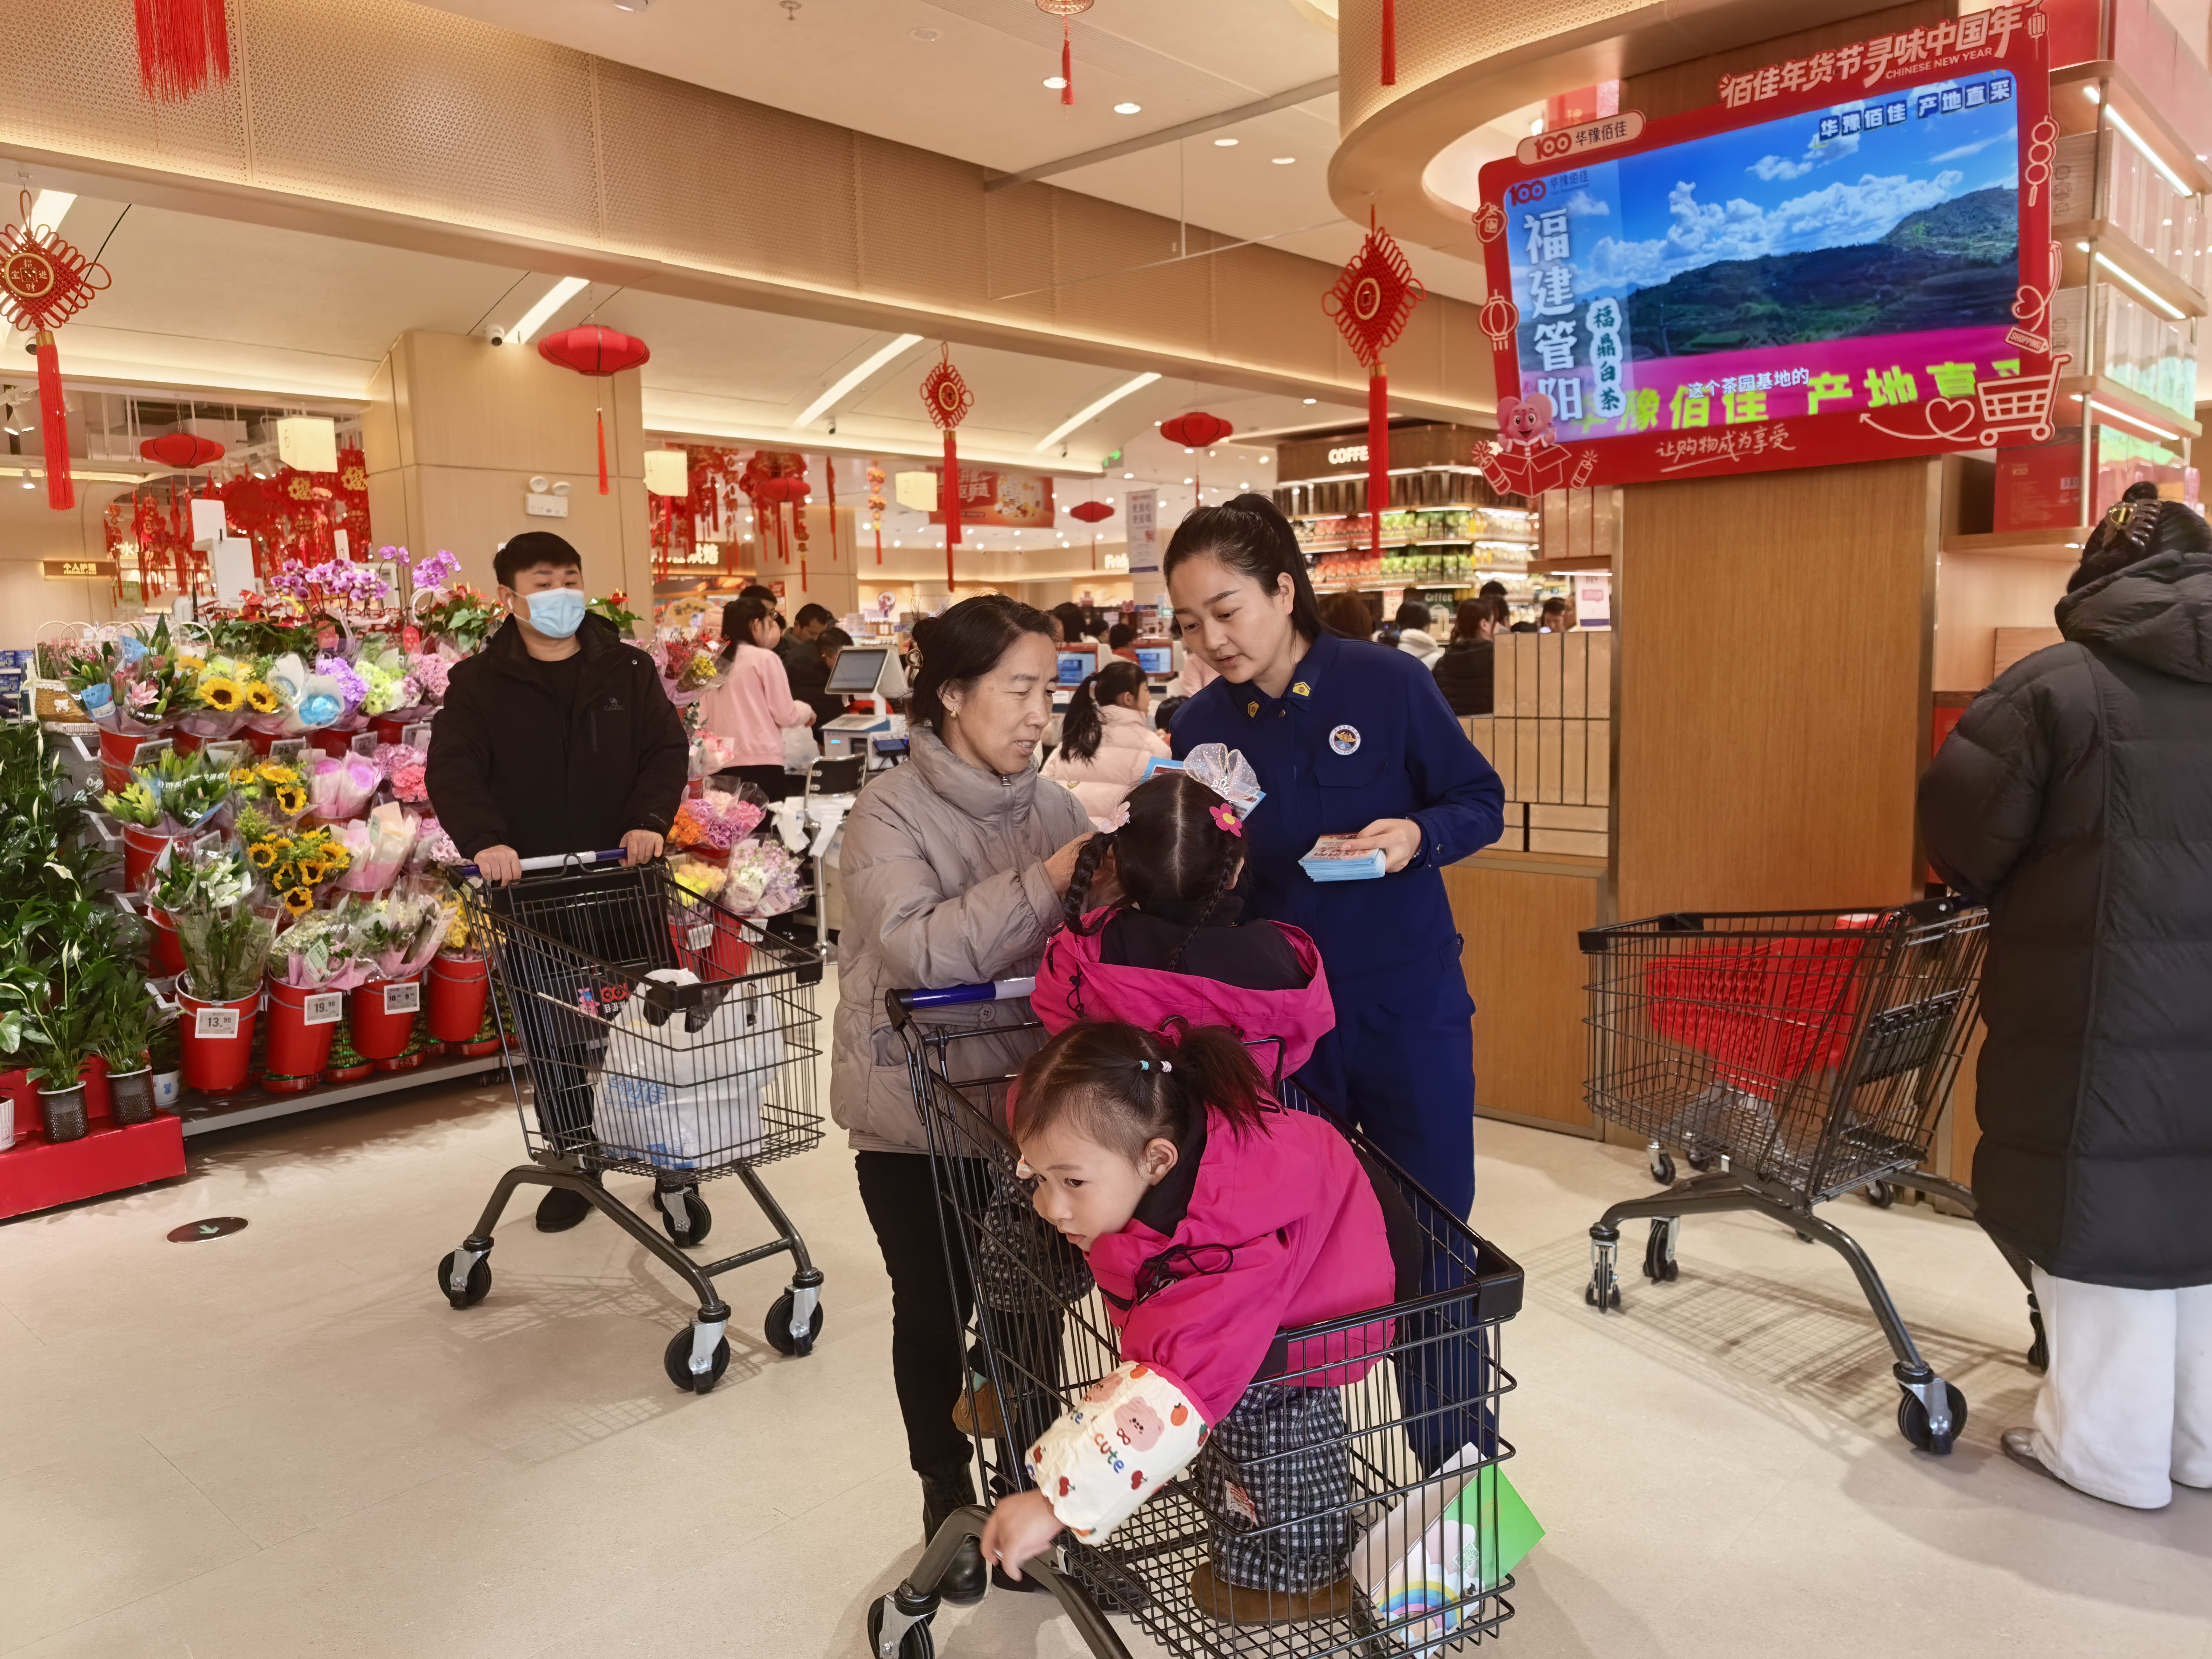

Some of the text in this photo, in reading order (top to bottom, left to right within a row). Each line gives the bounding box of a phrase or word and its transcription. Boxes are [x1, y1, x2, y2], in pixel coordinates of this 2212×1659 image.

[1722, 6, 2023, 108] 佰佳年货节寻味中国年
[1885, 47, 1992, 80] CHINESE NEW YEAR
[1820, 80, 2012, 138] 华豫佰佳 产地直采
[1534, 121, 1627, 161] 100 华豫佰佳
[1550, 169, 1589, 188] 华豫佰佳
[1523, 207, 1583, 421] 福建管阳
[2010, 331, 2043, 349] SHOPPING
[1593, 305, 1621, 411] 福鼎白茶
[1688, 367, 1809, 399] 这个茶园基地的
[284, 429, 290, 448] 6
[1328, 445, 1369, 464] COFFE
[1656, 423, 1796, 463] 让购物成为享受
[904, 479, 909, 493] 2
[63, 563, 96, 571] 个人护理
[1094, 1433, 1124, 1474] cute
